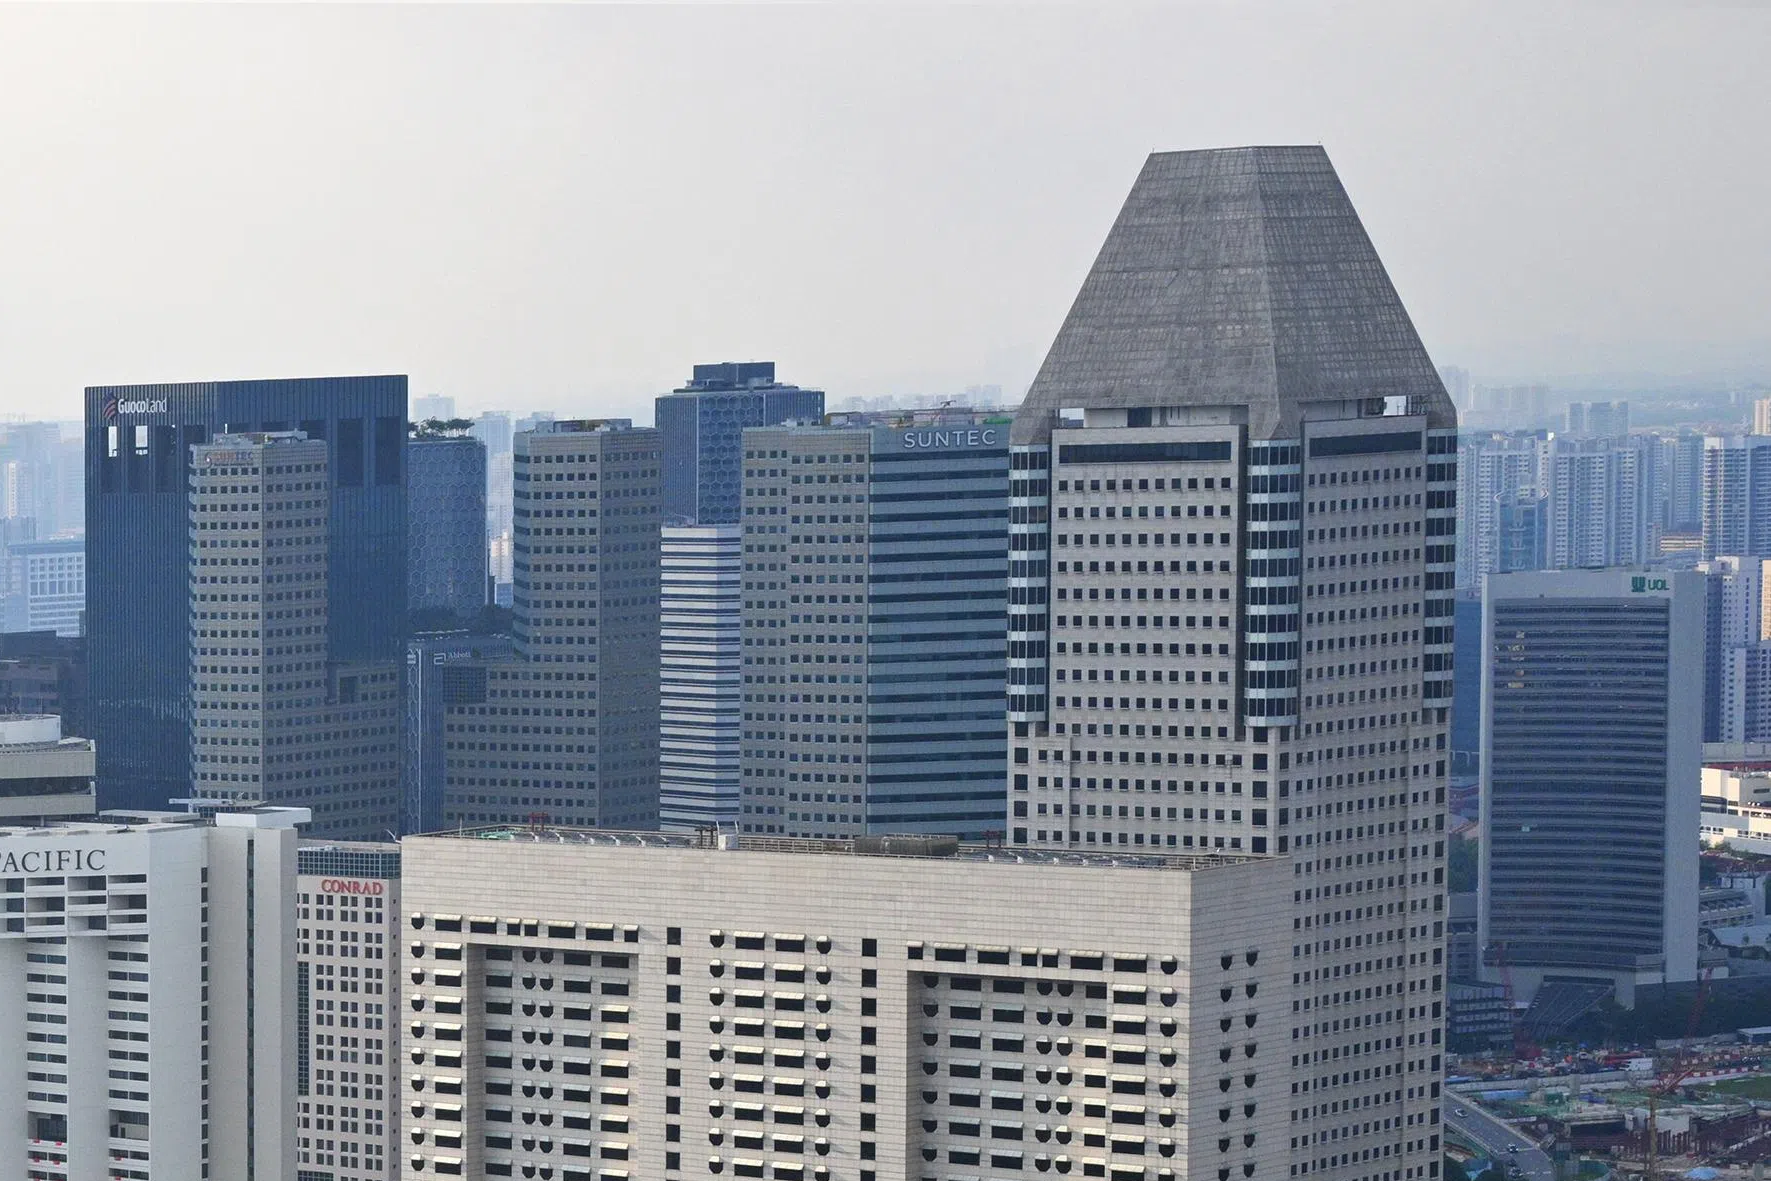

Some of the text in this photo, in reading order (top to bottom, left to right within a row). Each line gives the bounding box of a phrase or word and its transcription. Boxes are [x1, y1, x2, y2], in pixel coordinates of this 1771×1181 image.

[118, 397, 167, 413] GuocoLand
[904, 429, 996, 448] SUNTEC
[1648, 579, 1670, 591] UOL
[321, 879, 384, 896] CONRAD
